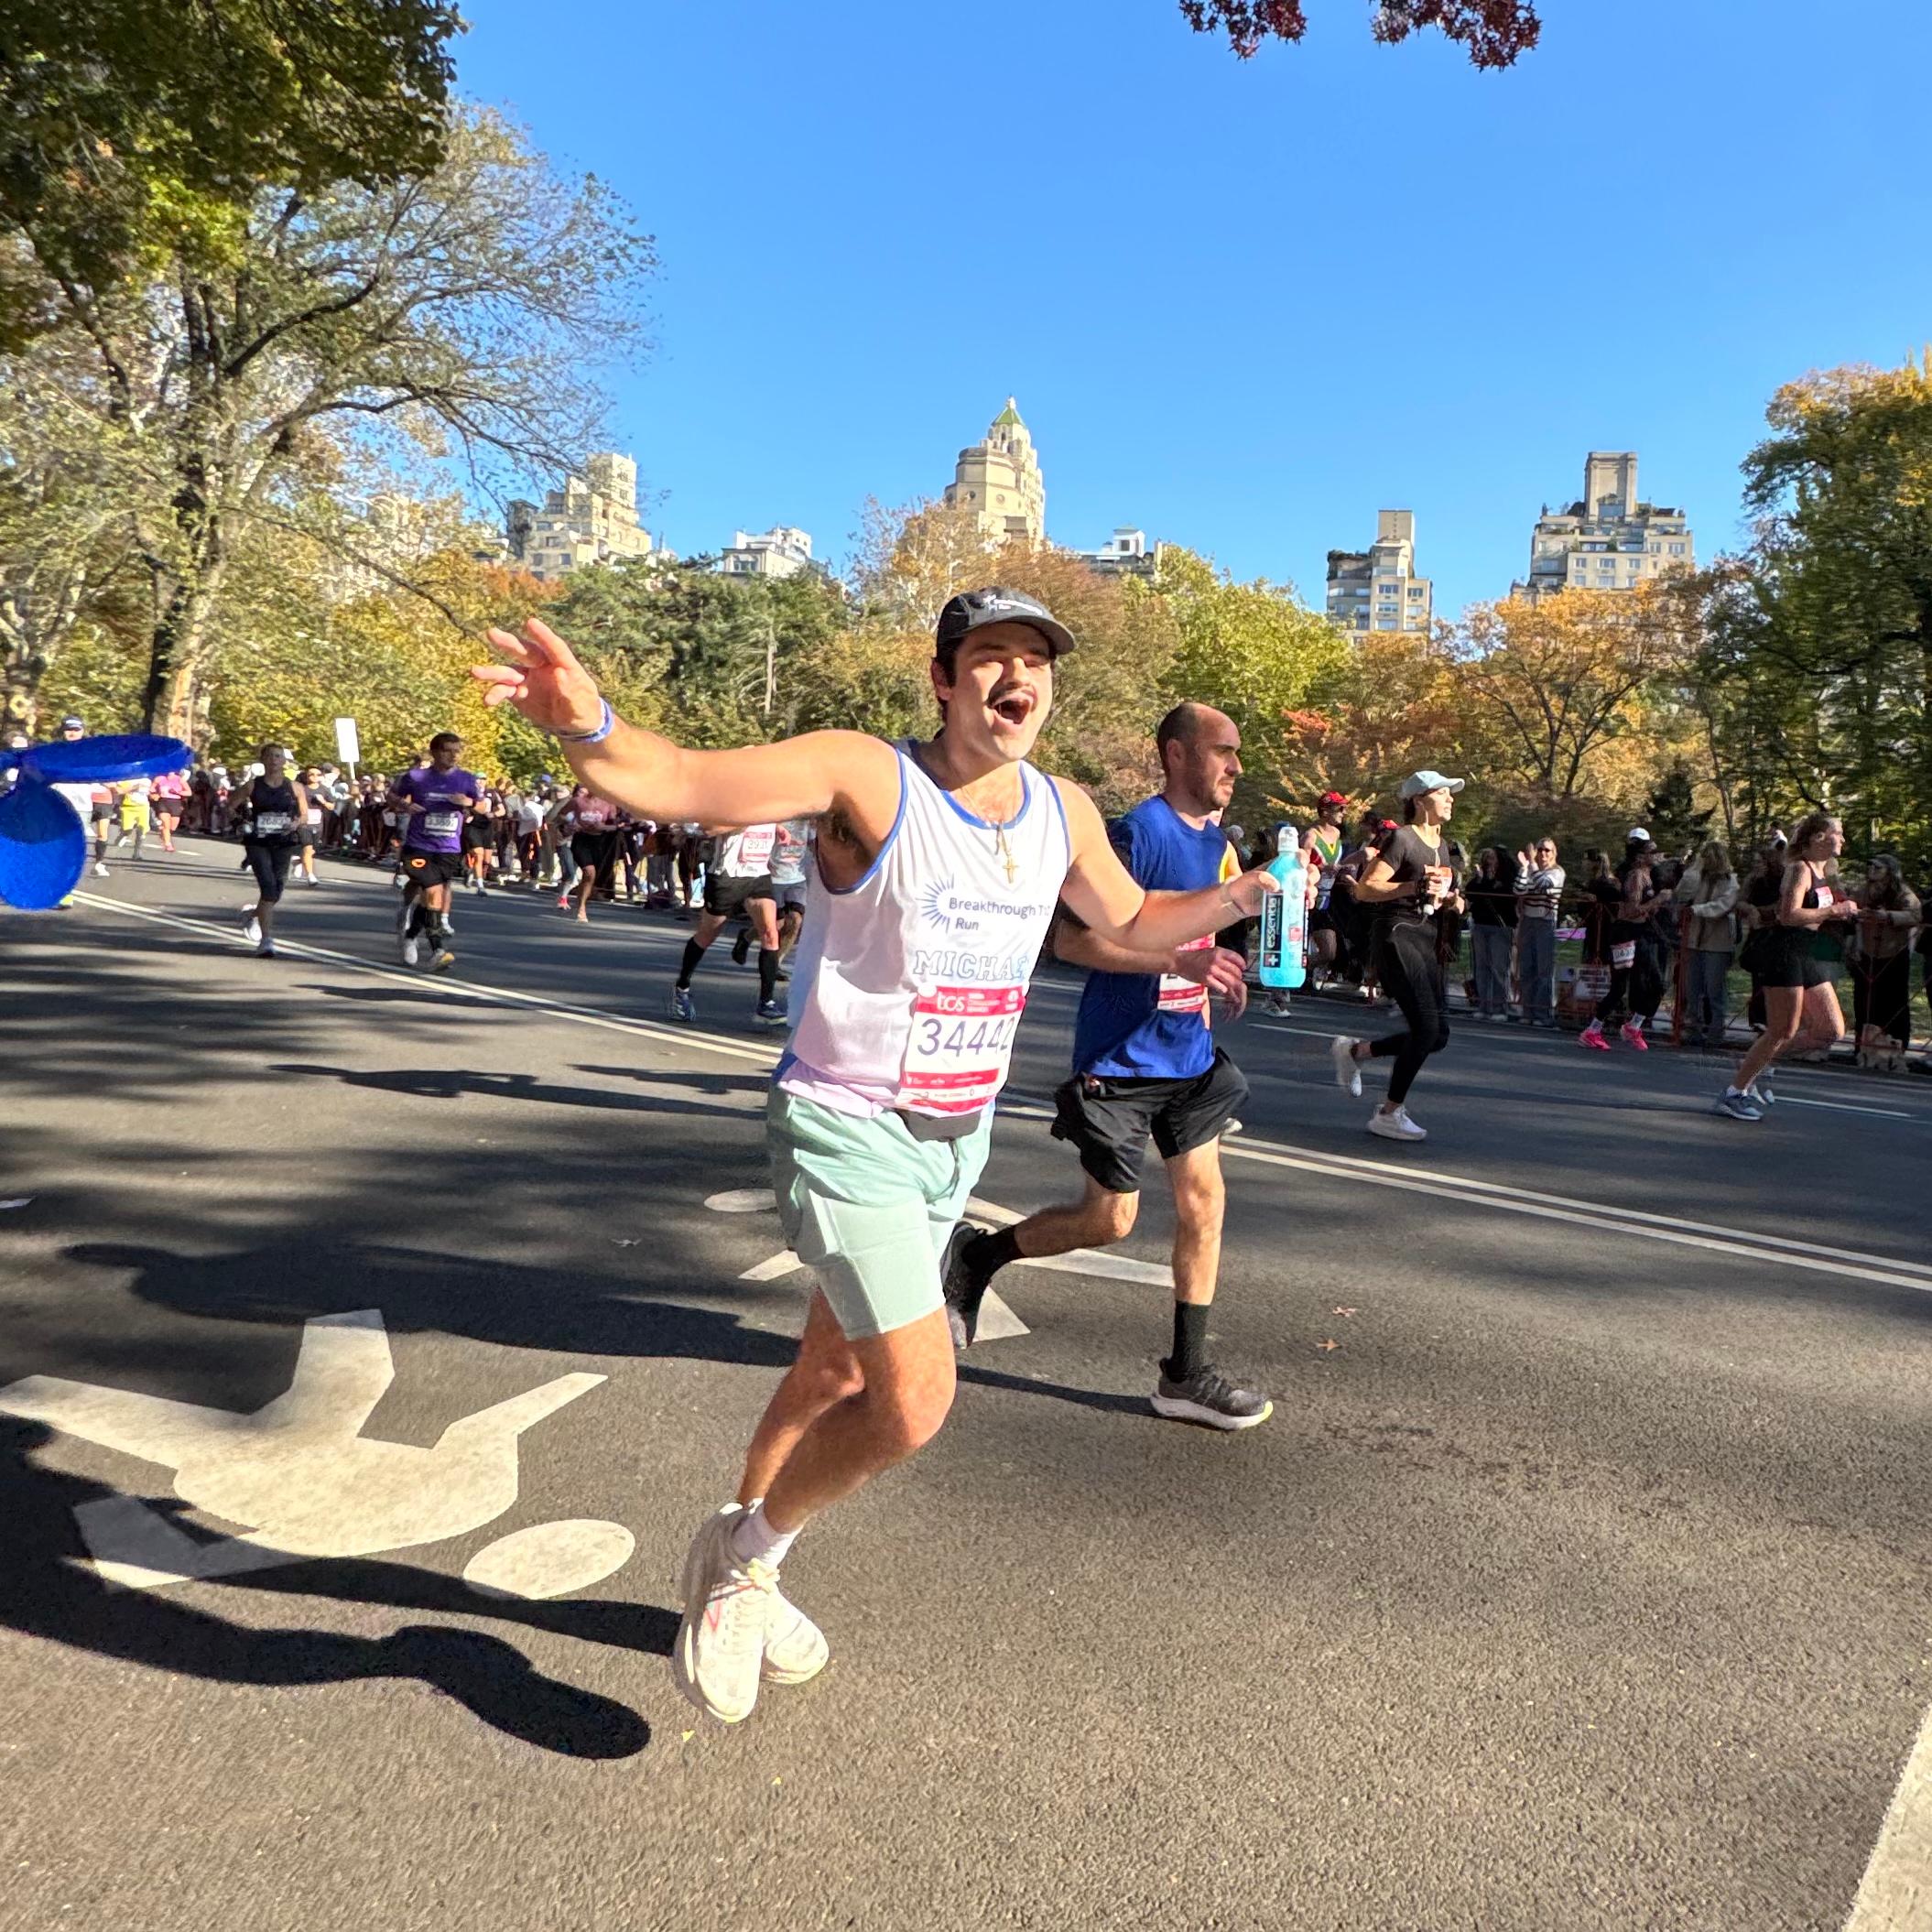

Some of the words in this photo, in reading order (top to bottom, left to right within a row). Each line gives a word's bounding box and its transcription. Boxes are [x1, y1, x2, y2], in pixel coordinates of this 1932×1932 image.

[949, 896, 1037, 920] Breakthrough
[955, 917, 980, 931] Run
[1266, 897, 1277, 949] essentia
